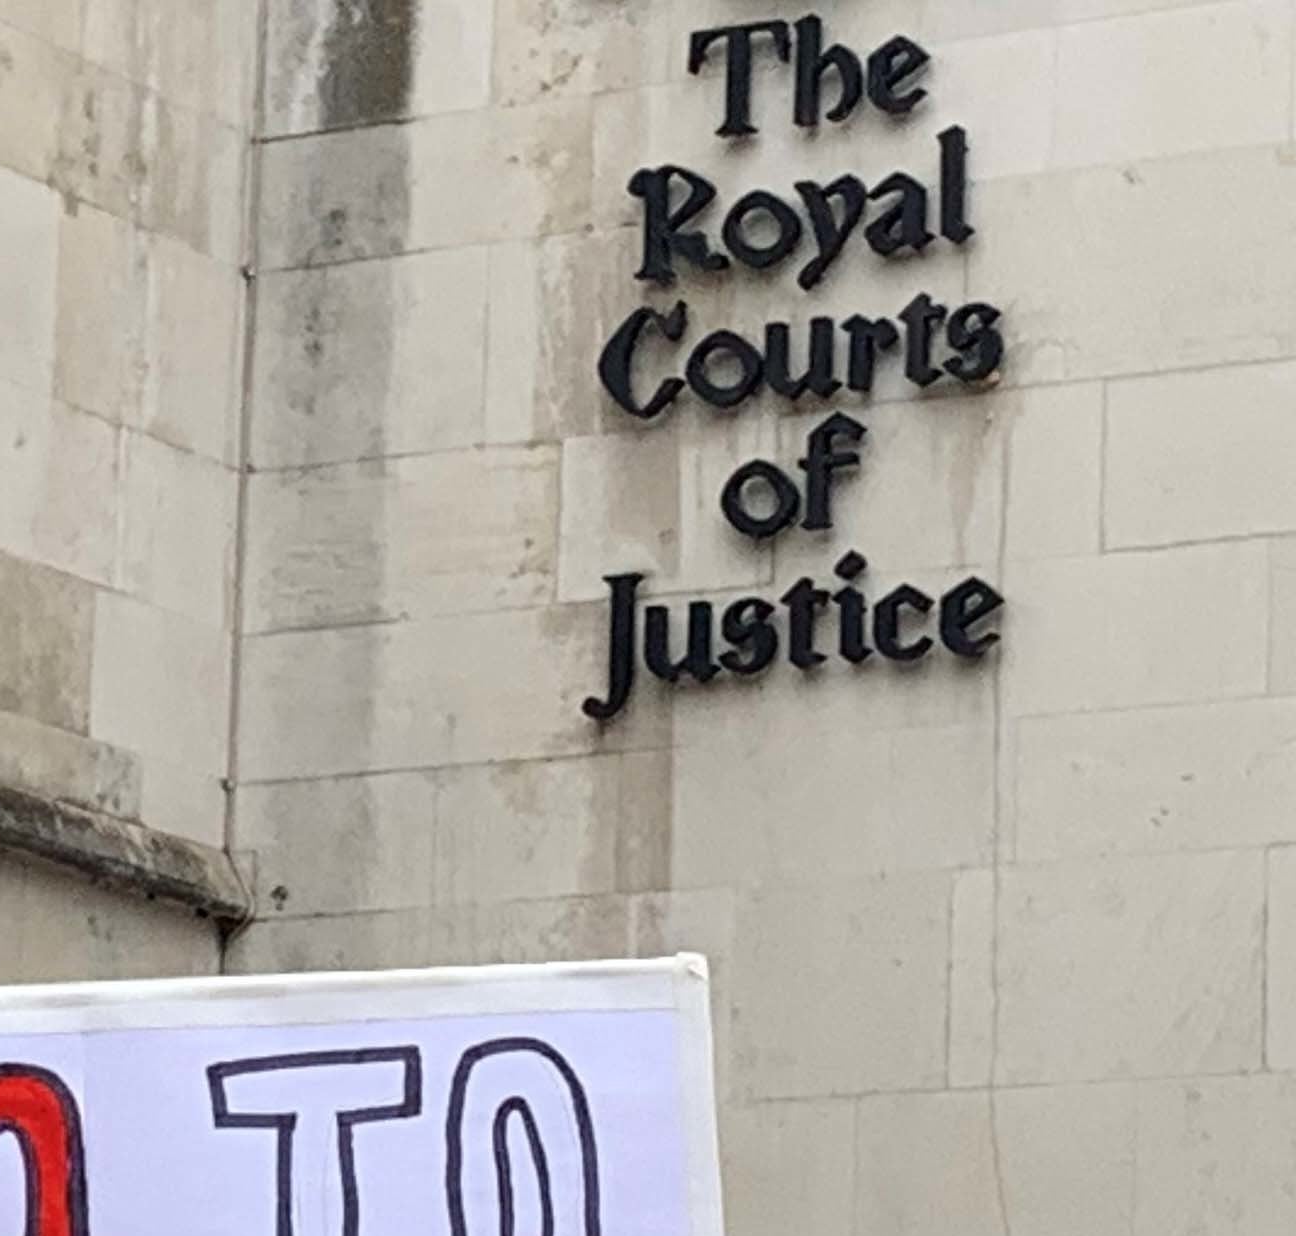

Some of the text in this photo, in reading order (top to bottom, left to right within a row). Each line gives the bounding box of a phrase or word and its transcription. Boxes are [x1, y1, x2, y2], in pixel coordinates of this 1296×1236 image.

[688, 15, 930, 137] The
[627, 126, 975, 291] Royal
[599, 292, 1008, 419] Courts
[722, 411, 867, 538] of
[582, 552, 1006, 719] Justice
